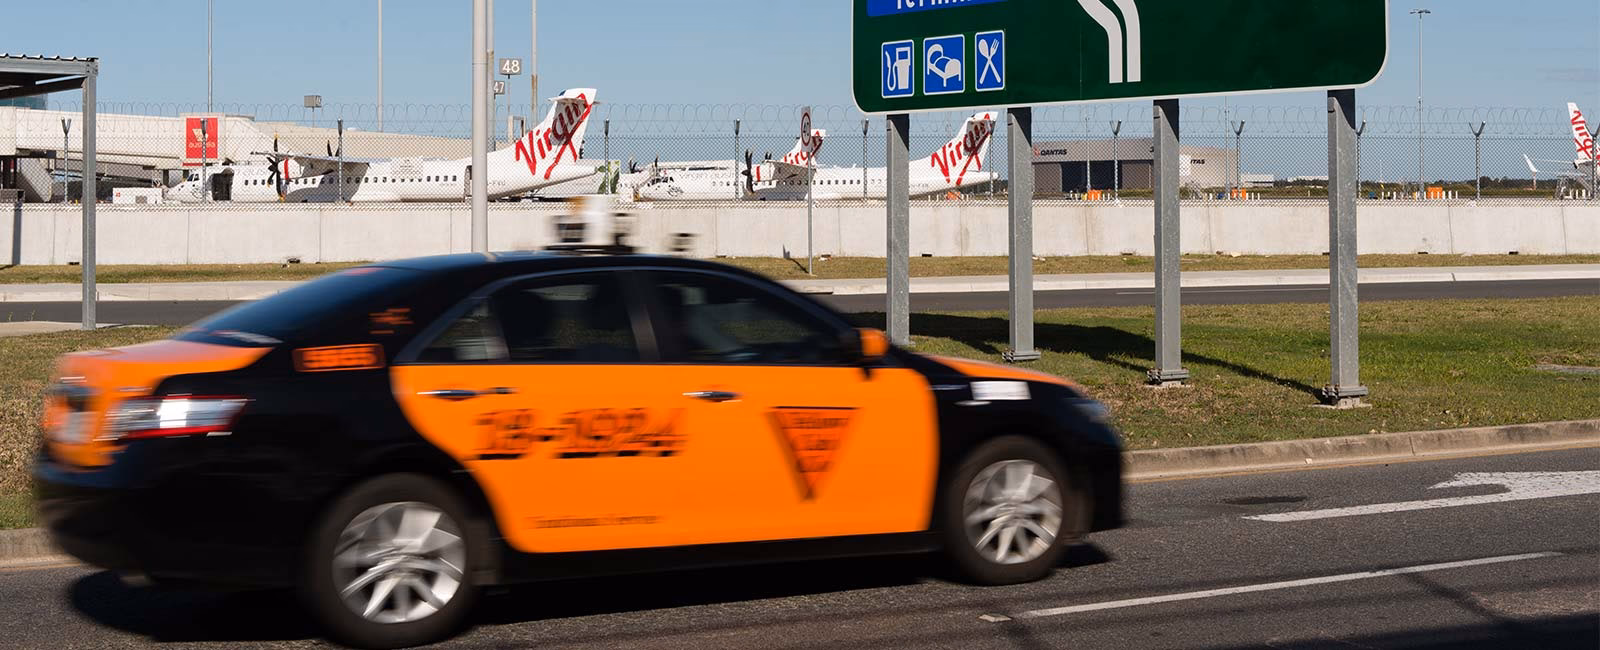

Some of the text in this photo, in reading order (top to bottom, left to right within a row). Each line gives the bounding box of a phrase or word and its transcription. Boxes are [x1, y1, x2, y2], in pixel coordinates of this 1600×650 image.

[502, 59, 520, 73] 48
[493, 81, 505, 93] 47
[514, 92, 592, 180] Virgin
[930, 112, 992, 186] Virgin
[1040, 148, 1068, 156] QANTAS
